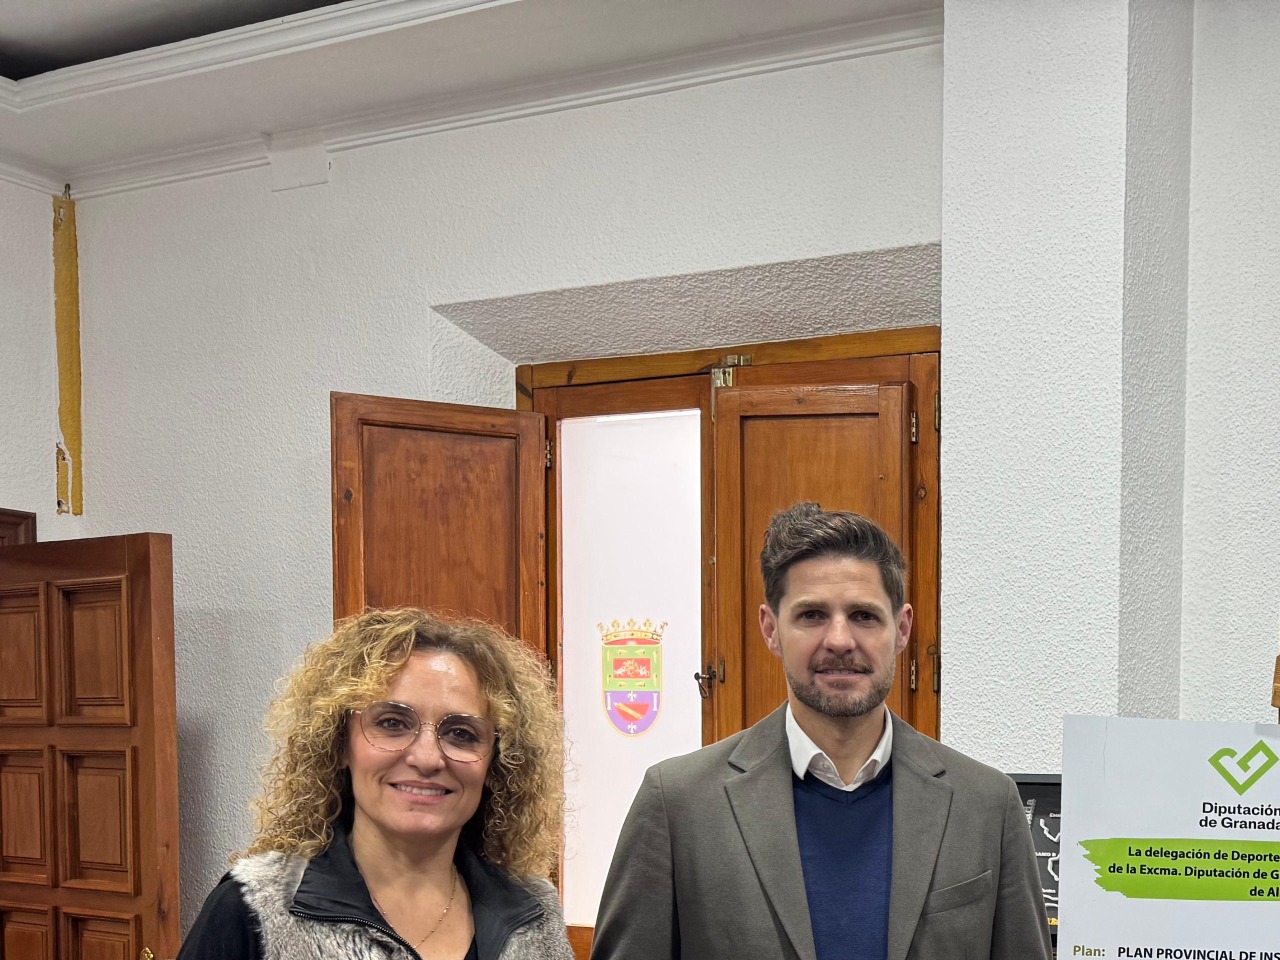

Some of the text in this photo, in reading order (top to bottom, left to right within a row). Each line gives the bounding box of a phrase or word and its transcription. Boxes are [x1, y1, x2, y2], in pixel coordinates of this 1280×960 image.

[1199, 816, 1217, 828] de
[1128, 846, 1141, 856] La
[1145, 846, 1210, 861] delegación
[1213, 849, 1228, 860] de
[1108, 863, 1123, 873] de
[1126, 863, 1136, 874] la
[1140, 864, 1181, 876] Excma.
[1185, 866, 1249, 879] Diputación
[1253, 868, 1268, 879] de
[1249, 886, 1264, 897] de
[1073, 945, 1105, 957] Plan:
[1118, 947, 1153, 958] PLAN
[1156, 948, 1236, 960] PROVINCIAL
